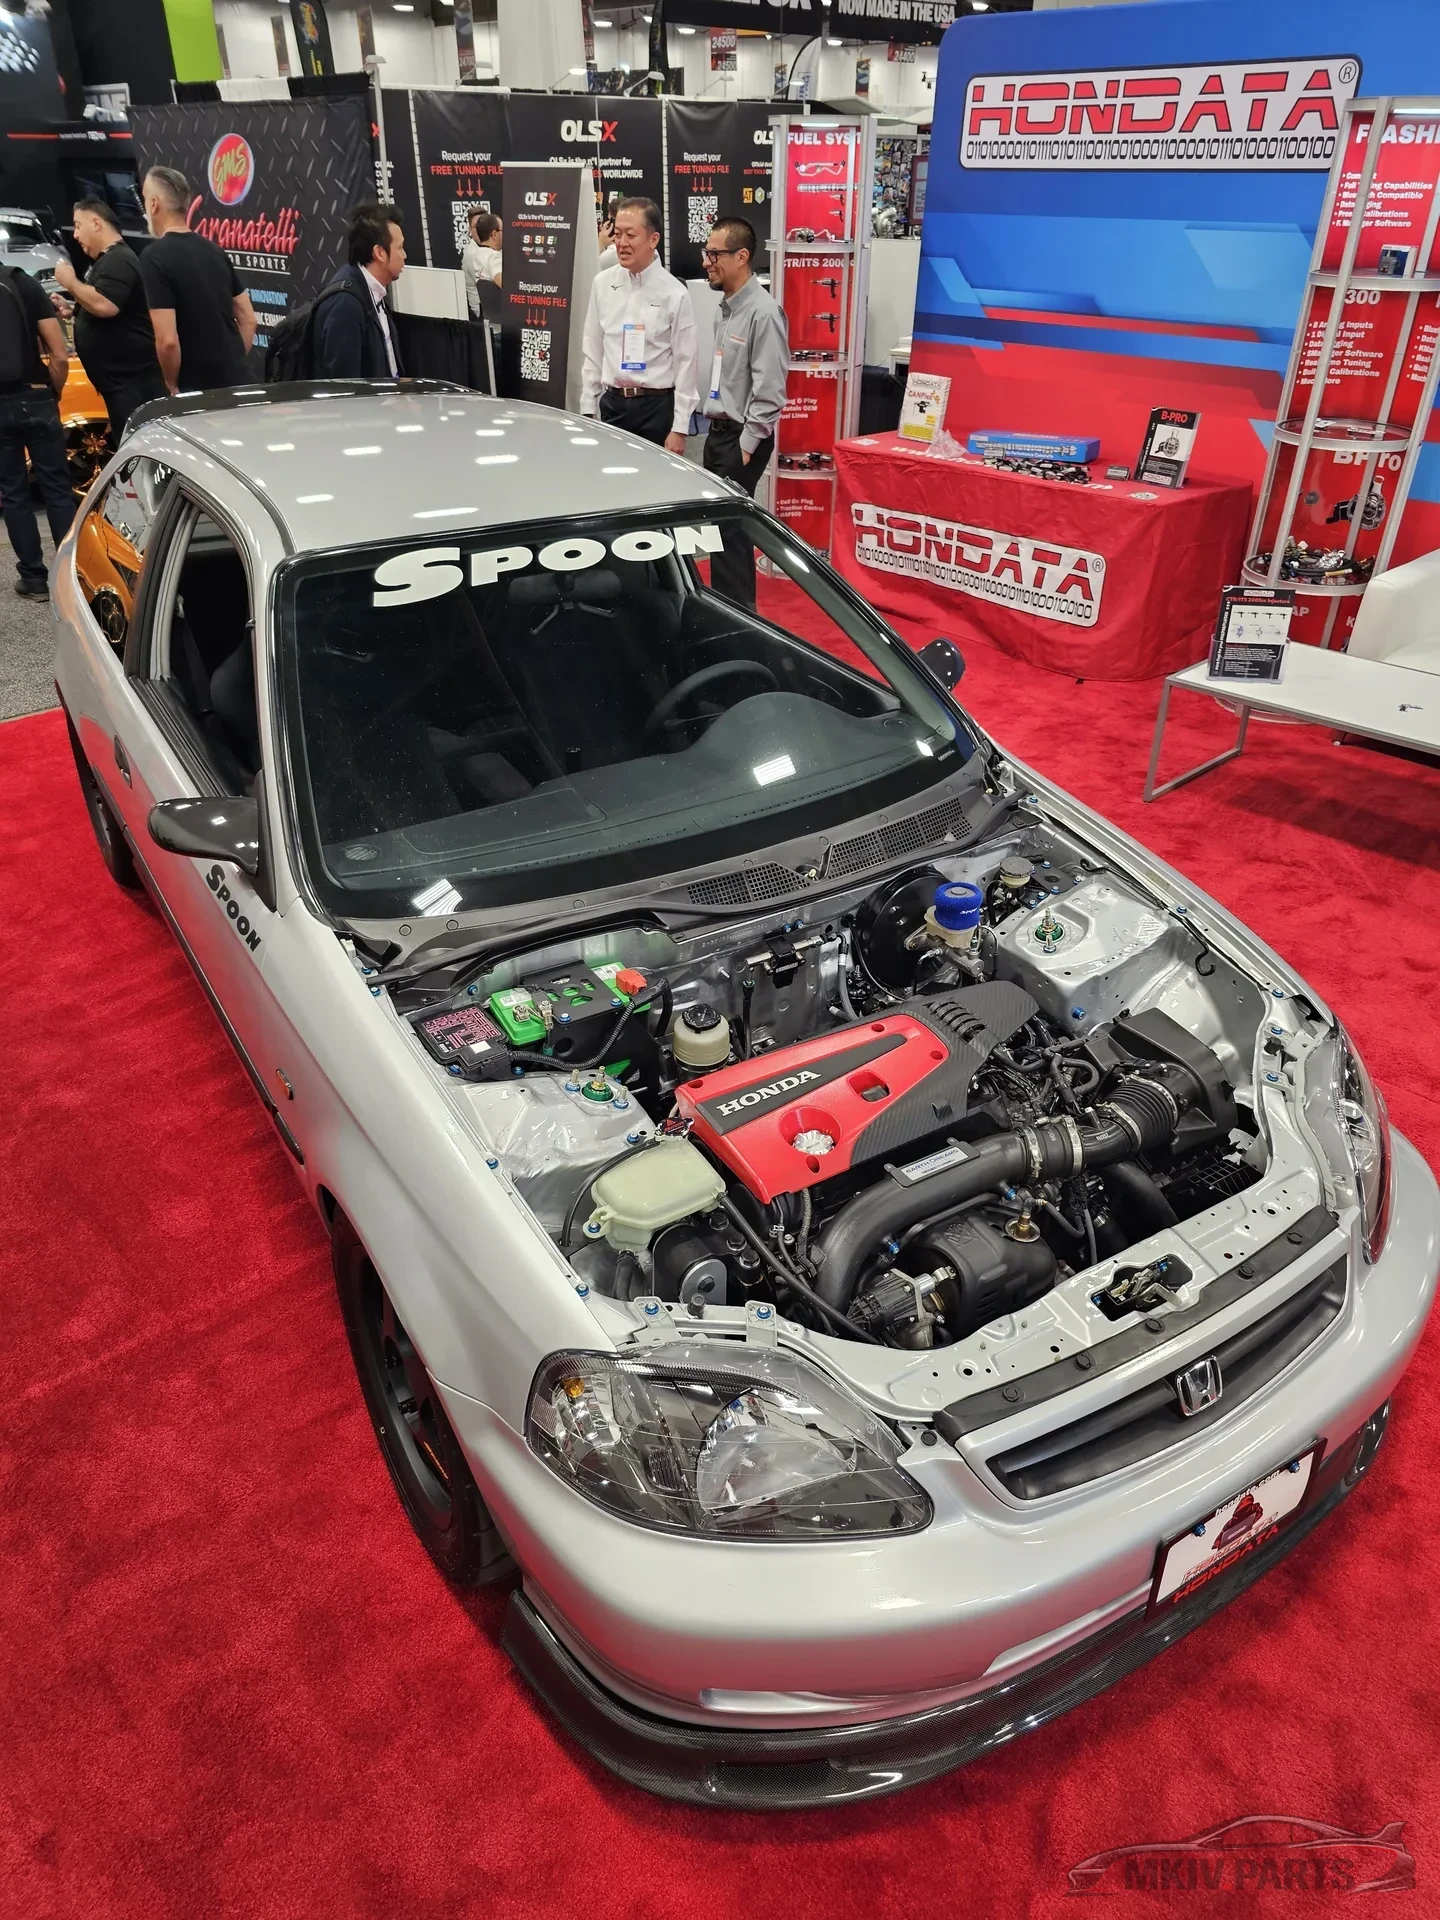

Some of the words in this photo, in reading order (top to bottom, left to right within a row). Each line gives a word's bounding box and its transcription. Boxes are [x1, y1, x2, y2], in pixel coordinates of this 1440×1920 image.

[838, 0, 866, 16] NOW
[866, 1, 899, 19] MADE
[900, 2, 911, 20] IN
[912, 3, 934, 22] THE
[934, 5, 956, 24] USA
[712, 35, 735, 48] 24500
[968, 69, 1340, 136] HONDATA
[560, 119, 618, 142] OLSX
[788, 132, 821, 146] FUEL
[441, 150, 473, 163] Request
[474, 152, 492, 163] your
[623, 158, 632, 167] for
[683, 152, 708, 163] Request
[708, 154, 722, 164] your
[431, 165, 453, 175] FREE
[454, 165, 486, 175] TUNING
[487, 165, 504, 175] FILE
[603, 169, 643, 178] WORLDWIDE
[674, 165, 691, 174] FREE
[692, 165, 716, 174] TUNING
[717, 165, 730, 174] FILE
[1384, 181, 1433, 191] Capabilities
[525, 192, 557, 206] OLSX
[1377, 191, 1423, 200] Compatible
[1374, 219, 1411, 228] Software
[246, 255, 286, 271] SPORTS
[518, 281, 542, 293] Request
[542, 286, 558, 295] your
[510, 294, 526, 304] FREE
[527, 295, 552, 306] TUNING
[552, 297, 568, 308] FILE
[1346, 321, 1374, 330] Inputs
[1342, 330, 1365, 339] Input
[1345, 350, 1384, 359] Software
[1343, 359, 1372, 368] Tuning
[1329, 368, 1380, 377] Calibrations
[1161, 410, 1188, 423] B-PRO
[854, 509, 1094, 602] HONDATA
[373, 525, 725, 608] SPOON
[205, 864, 262, 952] SPOON
[716, 1068, 821, 1116] HONDA
[1215, 1470, 1280, 1517] hondata.com
[1173, 1525, 1279, 1604] HONDATA
